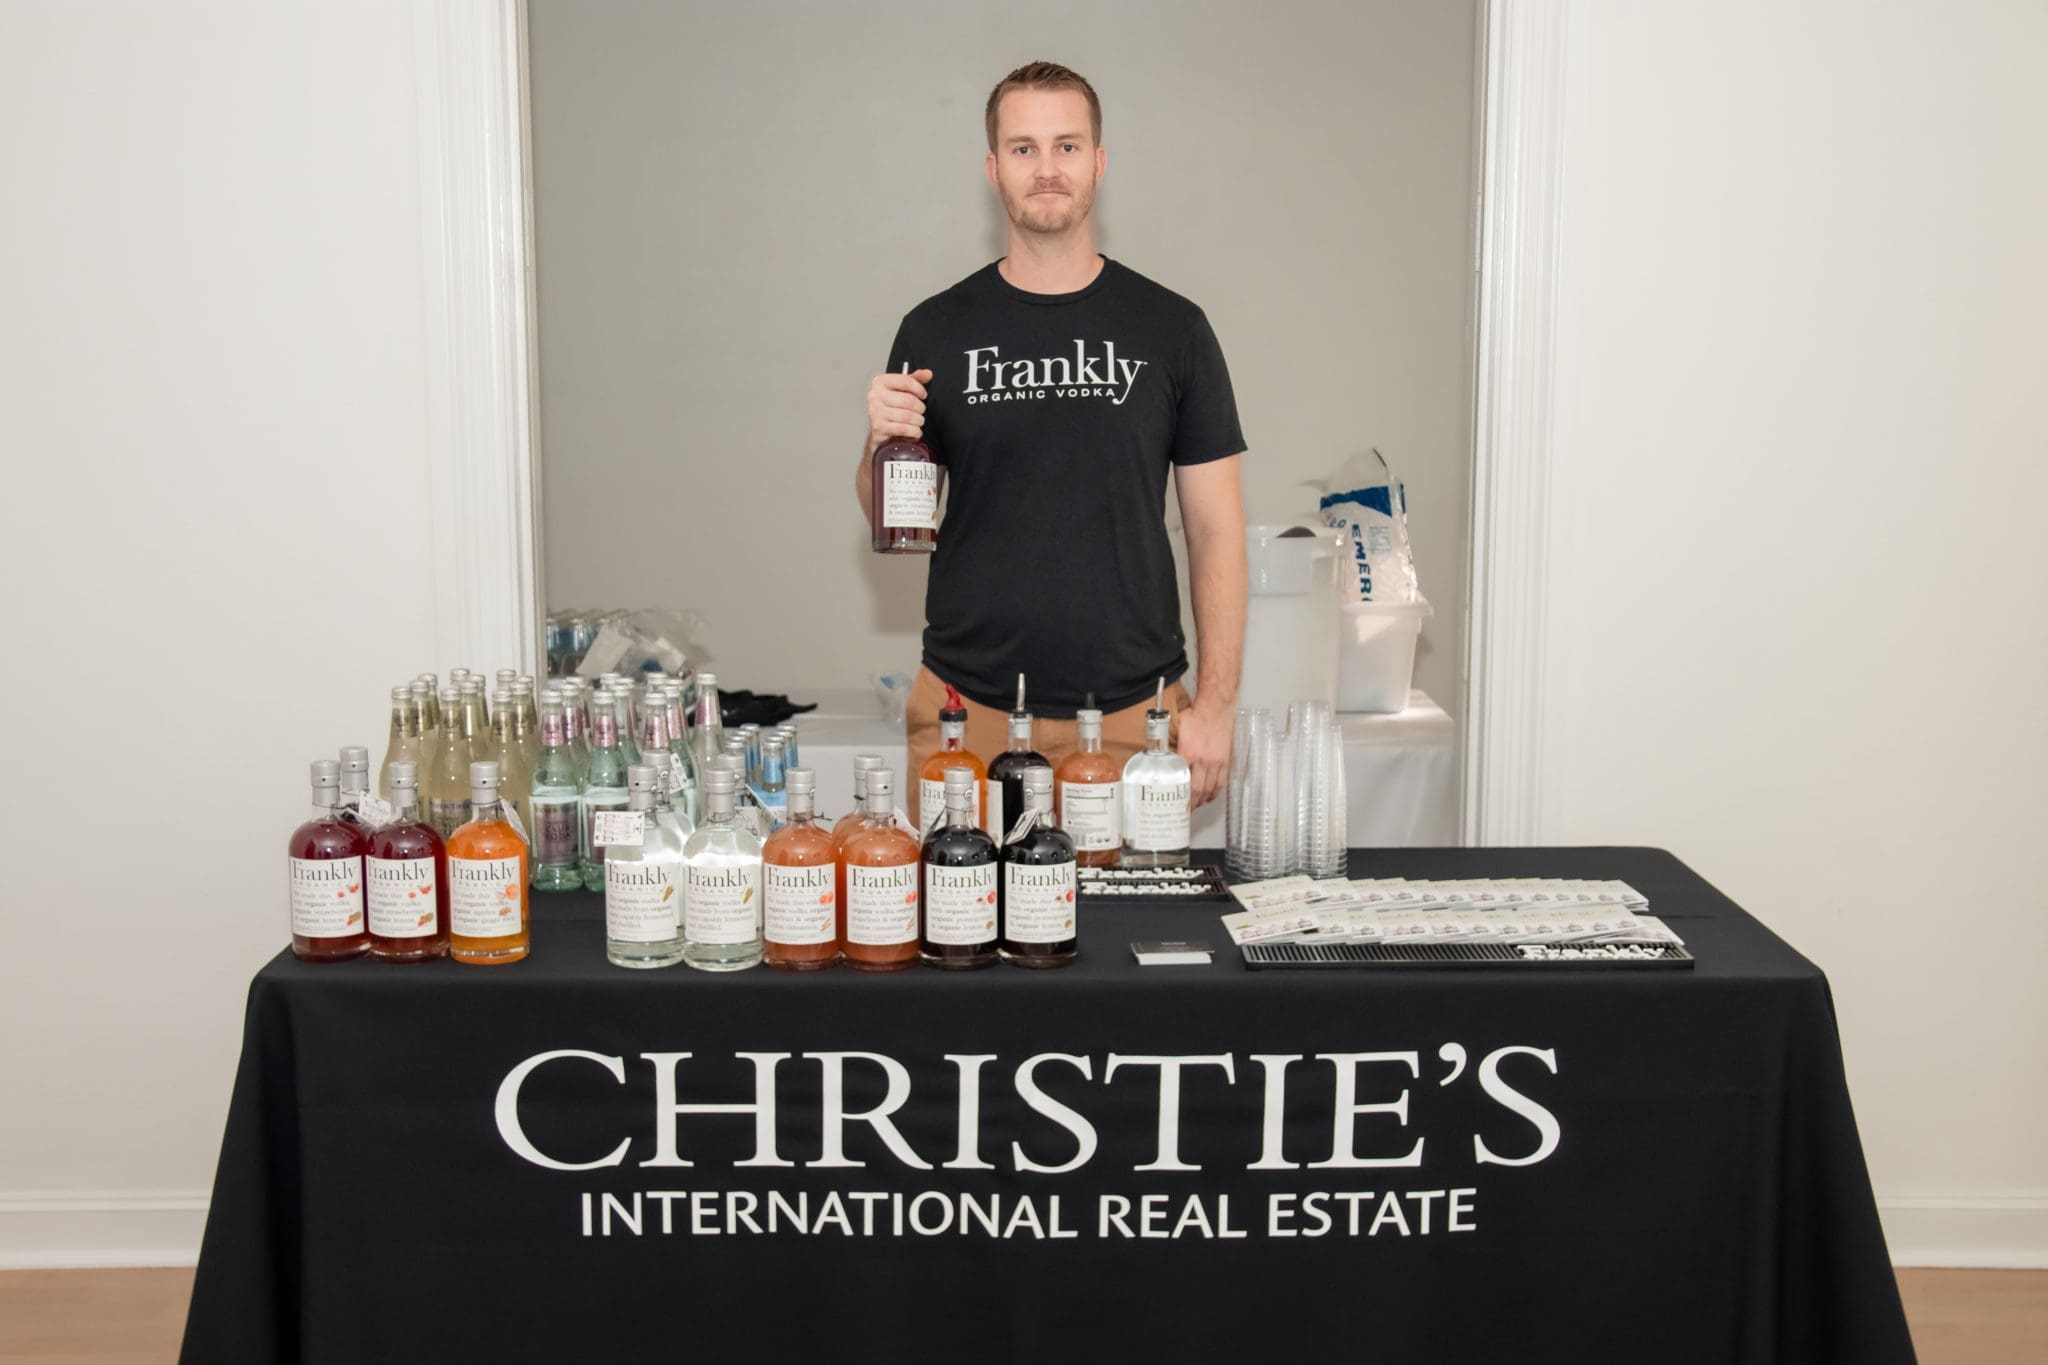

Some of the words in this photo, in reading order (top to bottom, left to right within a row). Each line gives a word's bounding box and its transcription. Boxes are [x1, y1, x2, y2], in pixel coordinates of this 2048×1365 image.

[963, 339, 1144, 405] Frankly
[967, 390, 1046, 405] ORGANIC
[1056, 388, 1115, 398] VODKA
[1351, 523, 1373, 602] EMER
[293, 860, 357, 886] Frankly
[368, 858, 430, 886] Frankly
[451, 859, 515, 887] Frankly
[609, 864, 671, 889] Frankly
[688, 866, 751, 891] Frankly
[768, 867, 831, 892] Frankly
[853, 868, 914, 892] Frankly
[932, 868, 993, 891] Frankly
[1011, 866, 1072, 890] Frankly
[1517, 944, 1664, 960] Frankly
[495, 1043, 1561, 1173] CHRISTIE'S
[582, 1190, 1079, 1240] INTERNATIONAL
[1098, 1193, 1247, 1240] REAL
[1268, 1187, 1477, 1238] ESTATE
